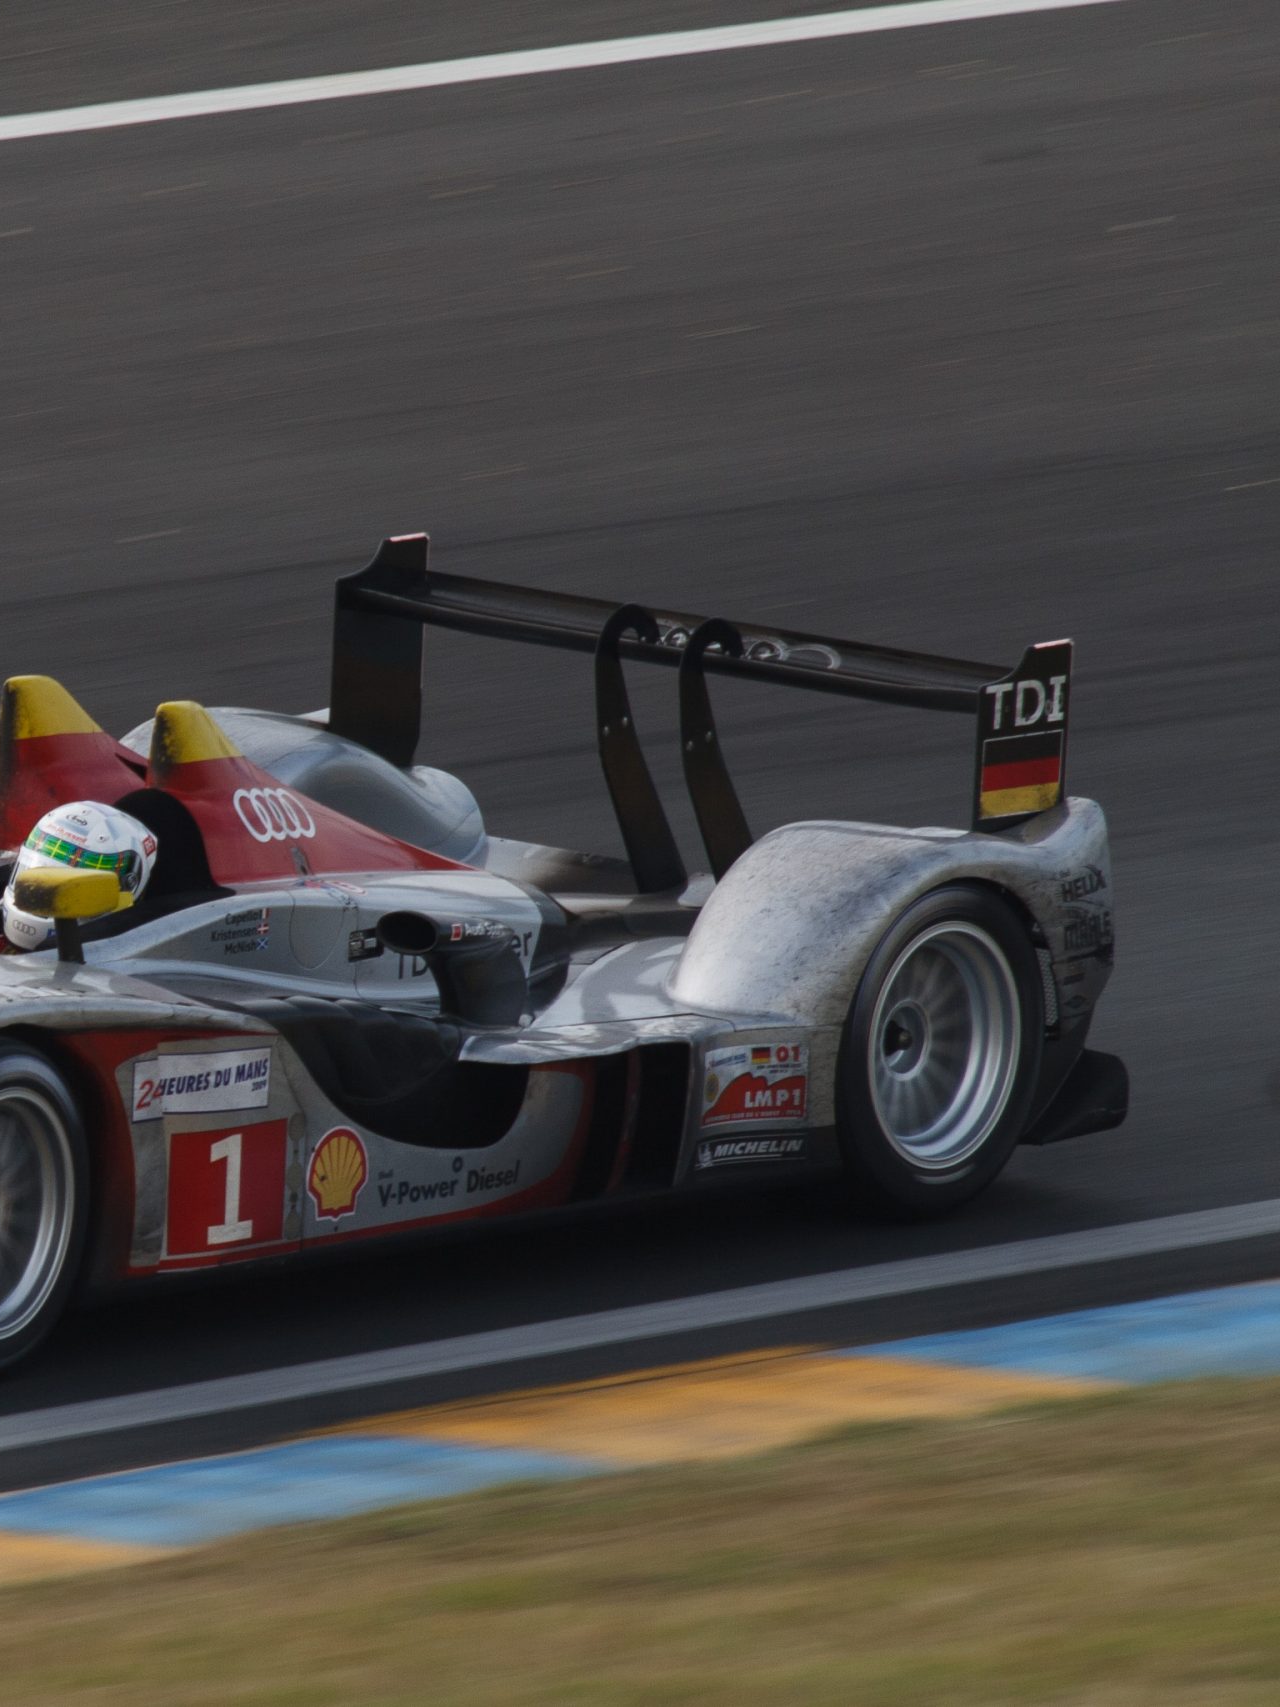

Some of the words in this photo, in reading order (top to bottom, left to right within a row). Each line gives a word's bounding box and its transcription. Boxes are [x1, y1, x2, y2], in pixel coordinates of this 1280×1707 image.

[985, 674, 1066, 730] TDI
[776, 1045, 800, 1065] 01
[157, 1071, 211, 1097] HEURES
[213, 1068, 232, 1089] DU
[234, 1058, 269, 1083] MANS
[714, 1139, 803, 1159] MICHELIN
[207, 1133, 253, 1245] 1
[378, 1179, 459, 1208] V-Power
[466, 1159, 520, 1194] Diesel
